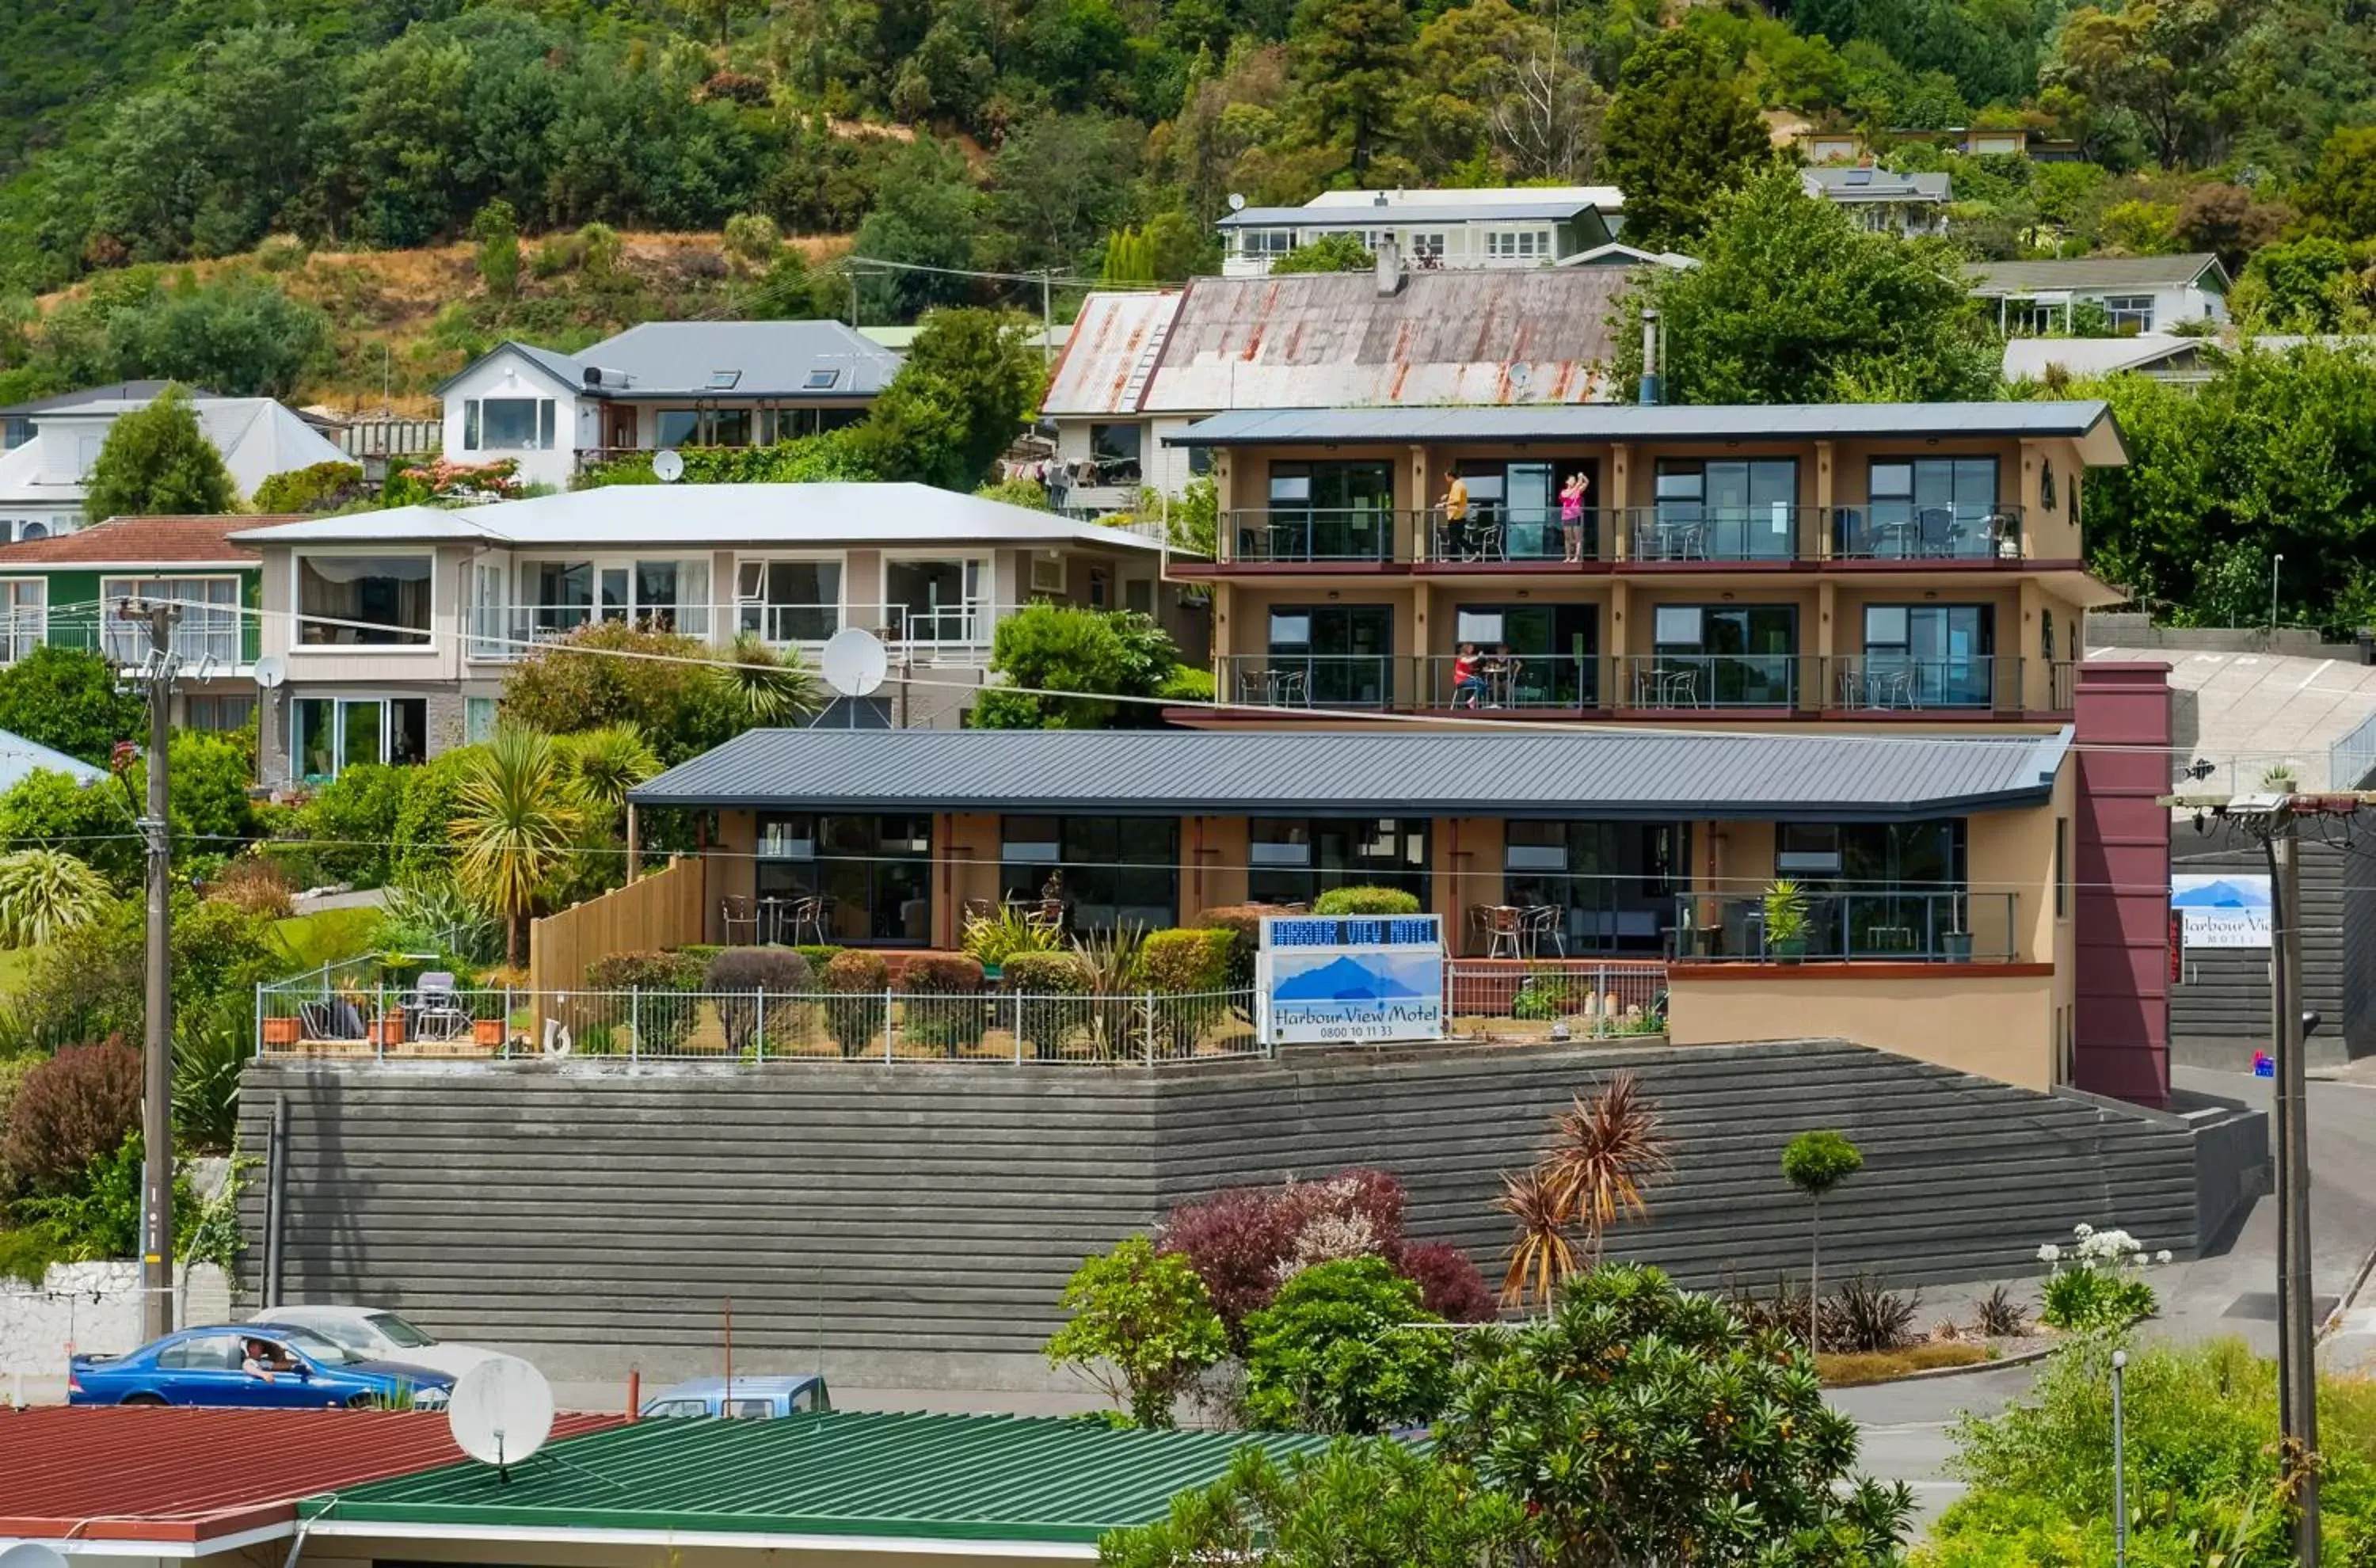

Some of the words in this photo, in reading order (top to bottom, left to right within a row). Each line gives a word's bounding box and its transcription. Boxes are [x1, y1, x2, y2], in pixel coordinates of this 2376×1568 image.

[1271, 920, 1338, 946] HARBOUR
[1347, 919, 1382, 945] VIEW
[1274, 1007, 1342, 1026] Harbour
[1346, 1007, 1384, 1023] View
[1388, 1005, 1437, 1022] Motel
[1320, 1027, 1347, 1038] 0800
[1351, 1026, 1362, 1037] 10
[1366, 1026, 1376, 1037] 11
[1380, 1026, 1392, 1037] 33
